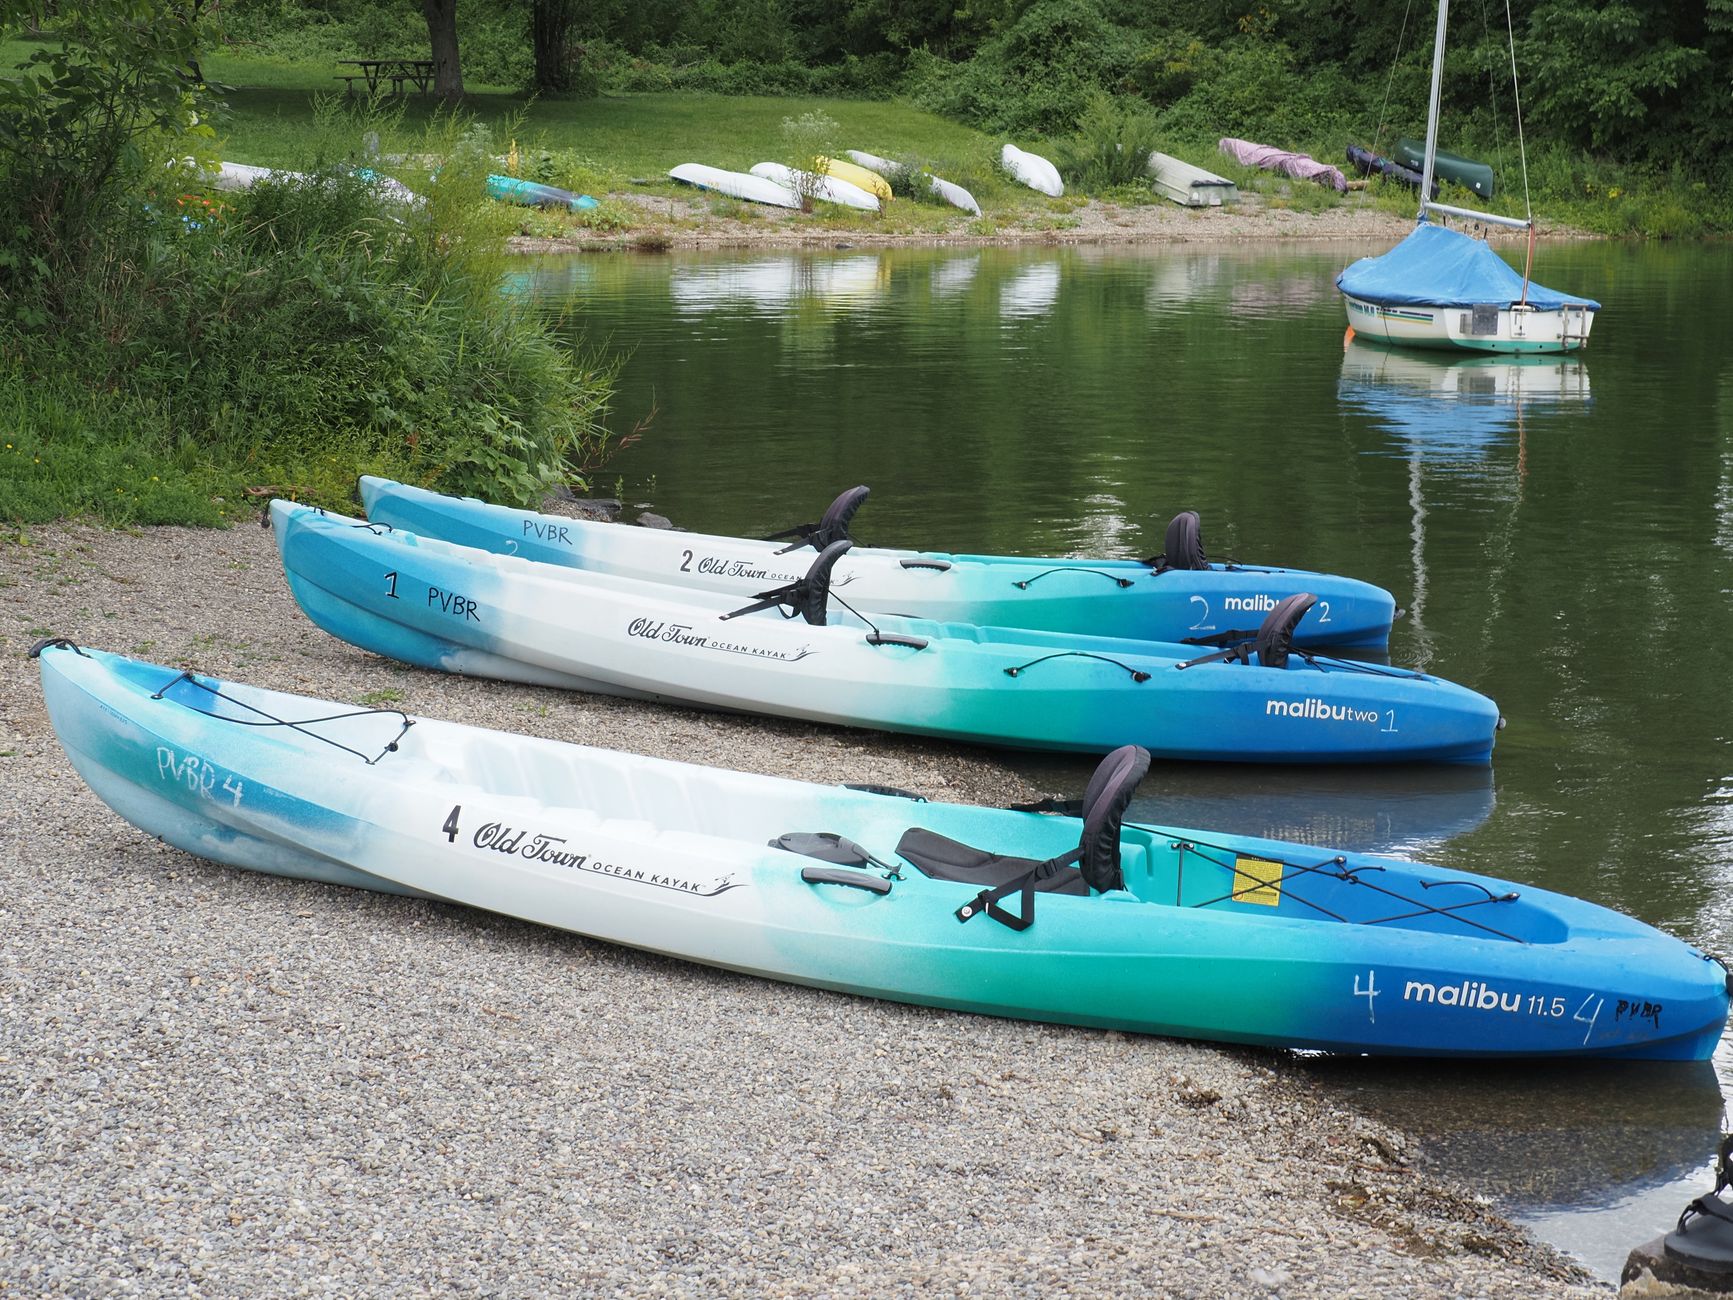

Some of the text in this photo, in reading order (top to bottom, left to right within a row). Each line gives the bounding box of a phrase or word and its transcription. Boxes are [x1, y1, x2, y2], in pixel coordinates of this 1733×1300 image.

[523, 519, 573, 546] PVBR
[680, 549, 693, 573] 2
[697, 556, 728, 575] Old
[727, 560, 766, 579] Town
[383, 571, 400, 600] 1
[1225, 594, 1280, 611] malib
[428, 587, 480, 622] PVBR
[1189, 595, 1216, 630] 2
[1319, 602, 1331, 623] 2
[627, 617, 787, 659] Old Town OCEAN KAYAK
[1381, 709, 1398, 732] 1
[156, 746, 244, 809] PVBR 4
[442, 804, 462, 843] 4
[473, 821, 701, 892] Old Town OCEAN KAYAK
[1353, 969, 1382, 1025] 4
[1403, 980, 1566, 1018] malibu 11.5
[1573, 992, 1605, 1045] 4
